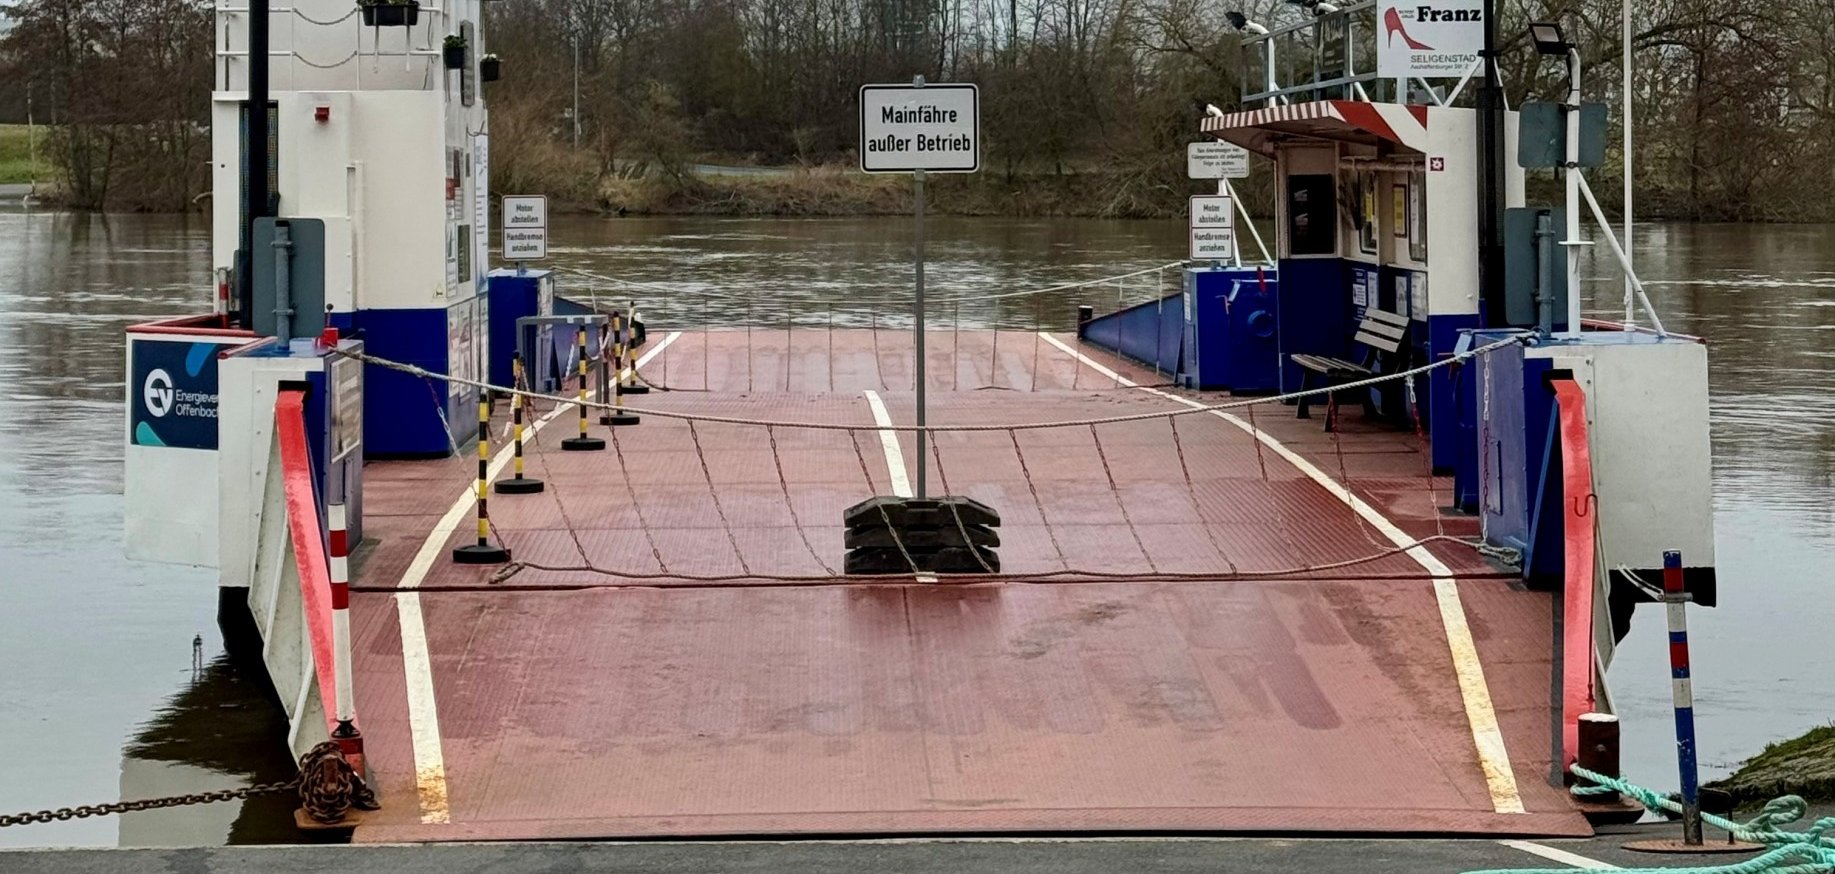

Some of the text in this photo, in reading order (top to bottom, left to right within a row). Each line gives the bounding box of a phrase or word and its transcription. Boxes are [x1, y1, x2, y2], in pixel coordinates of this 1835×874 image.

[1416, 5, 1481, 22] Franz
[1410, 54, 1477, 63] SELIGENSTAD
[881, 105, 957, 124] Mainfähre
[868, 133, 970, 152] außer Betrieb
[515, 203, 533, 212] Motor
[1203, 203, 1220, 212] Motor
[1194, 231, 1230, 241] Handbremse
[175, 389, 218, 405] Energieve
[175, 403, 218, 418] Offenbac
